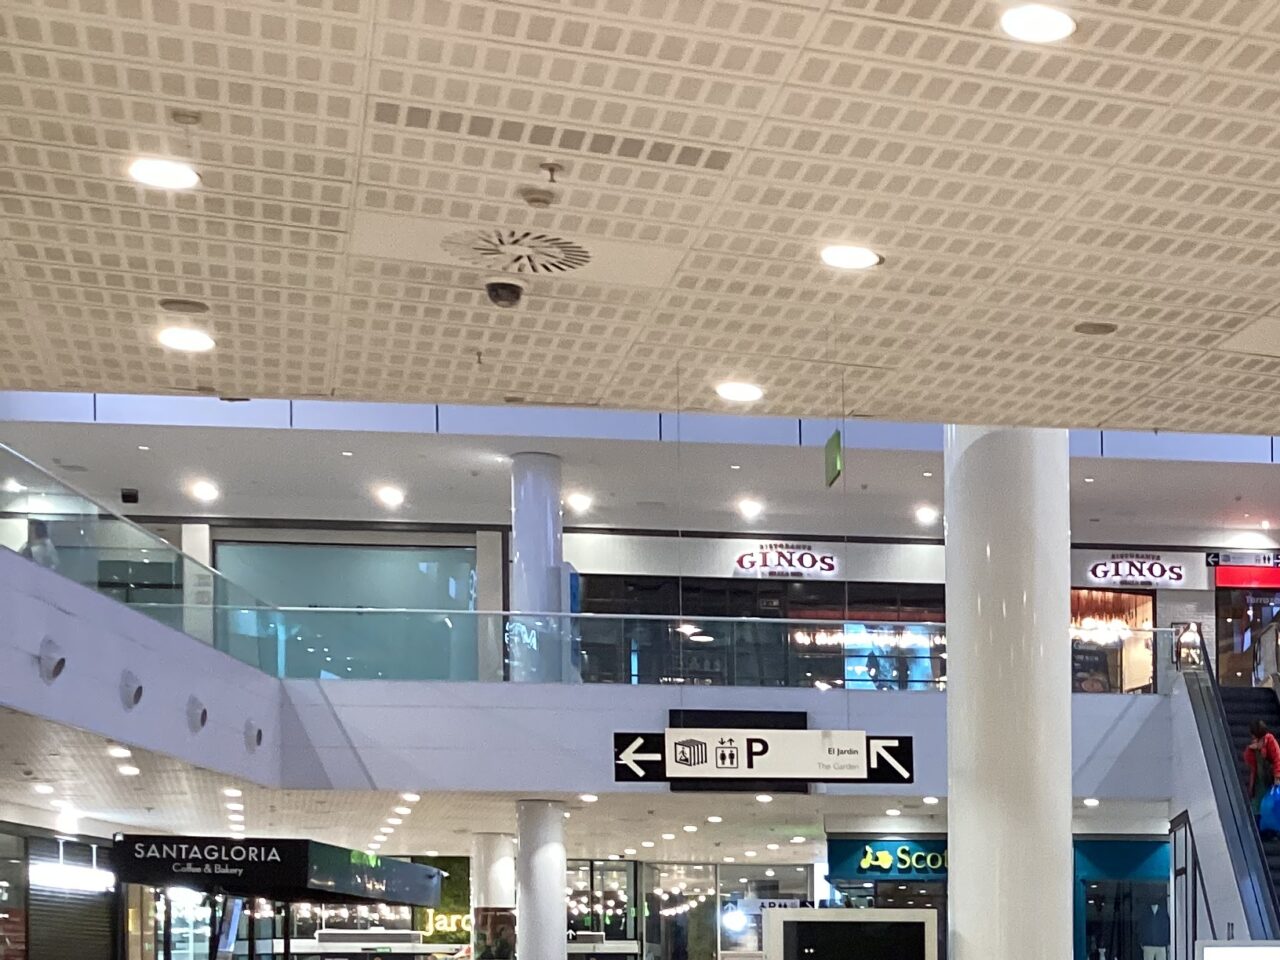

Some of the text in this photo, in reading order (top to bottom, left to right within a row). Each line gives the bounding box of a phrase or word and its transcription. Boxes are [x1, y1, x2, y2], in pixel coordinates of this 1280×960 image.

[736, 550, 835, 571] GINOS
[1090, 561, 1183, 580] GINOS
[746, 738, 769, 769] P
[828, 747, 836, 755] El
[818, 762, 860, 771] The Garden
[134, 843, 281, 862] SANTAGLORIA
[172, 863, 243, 877] Coffee & Bakery
